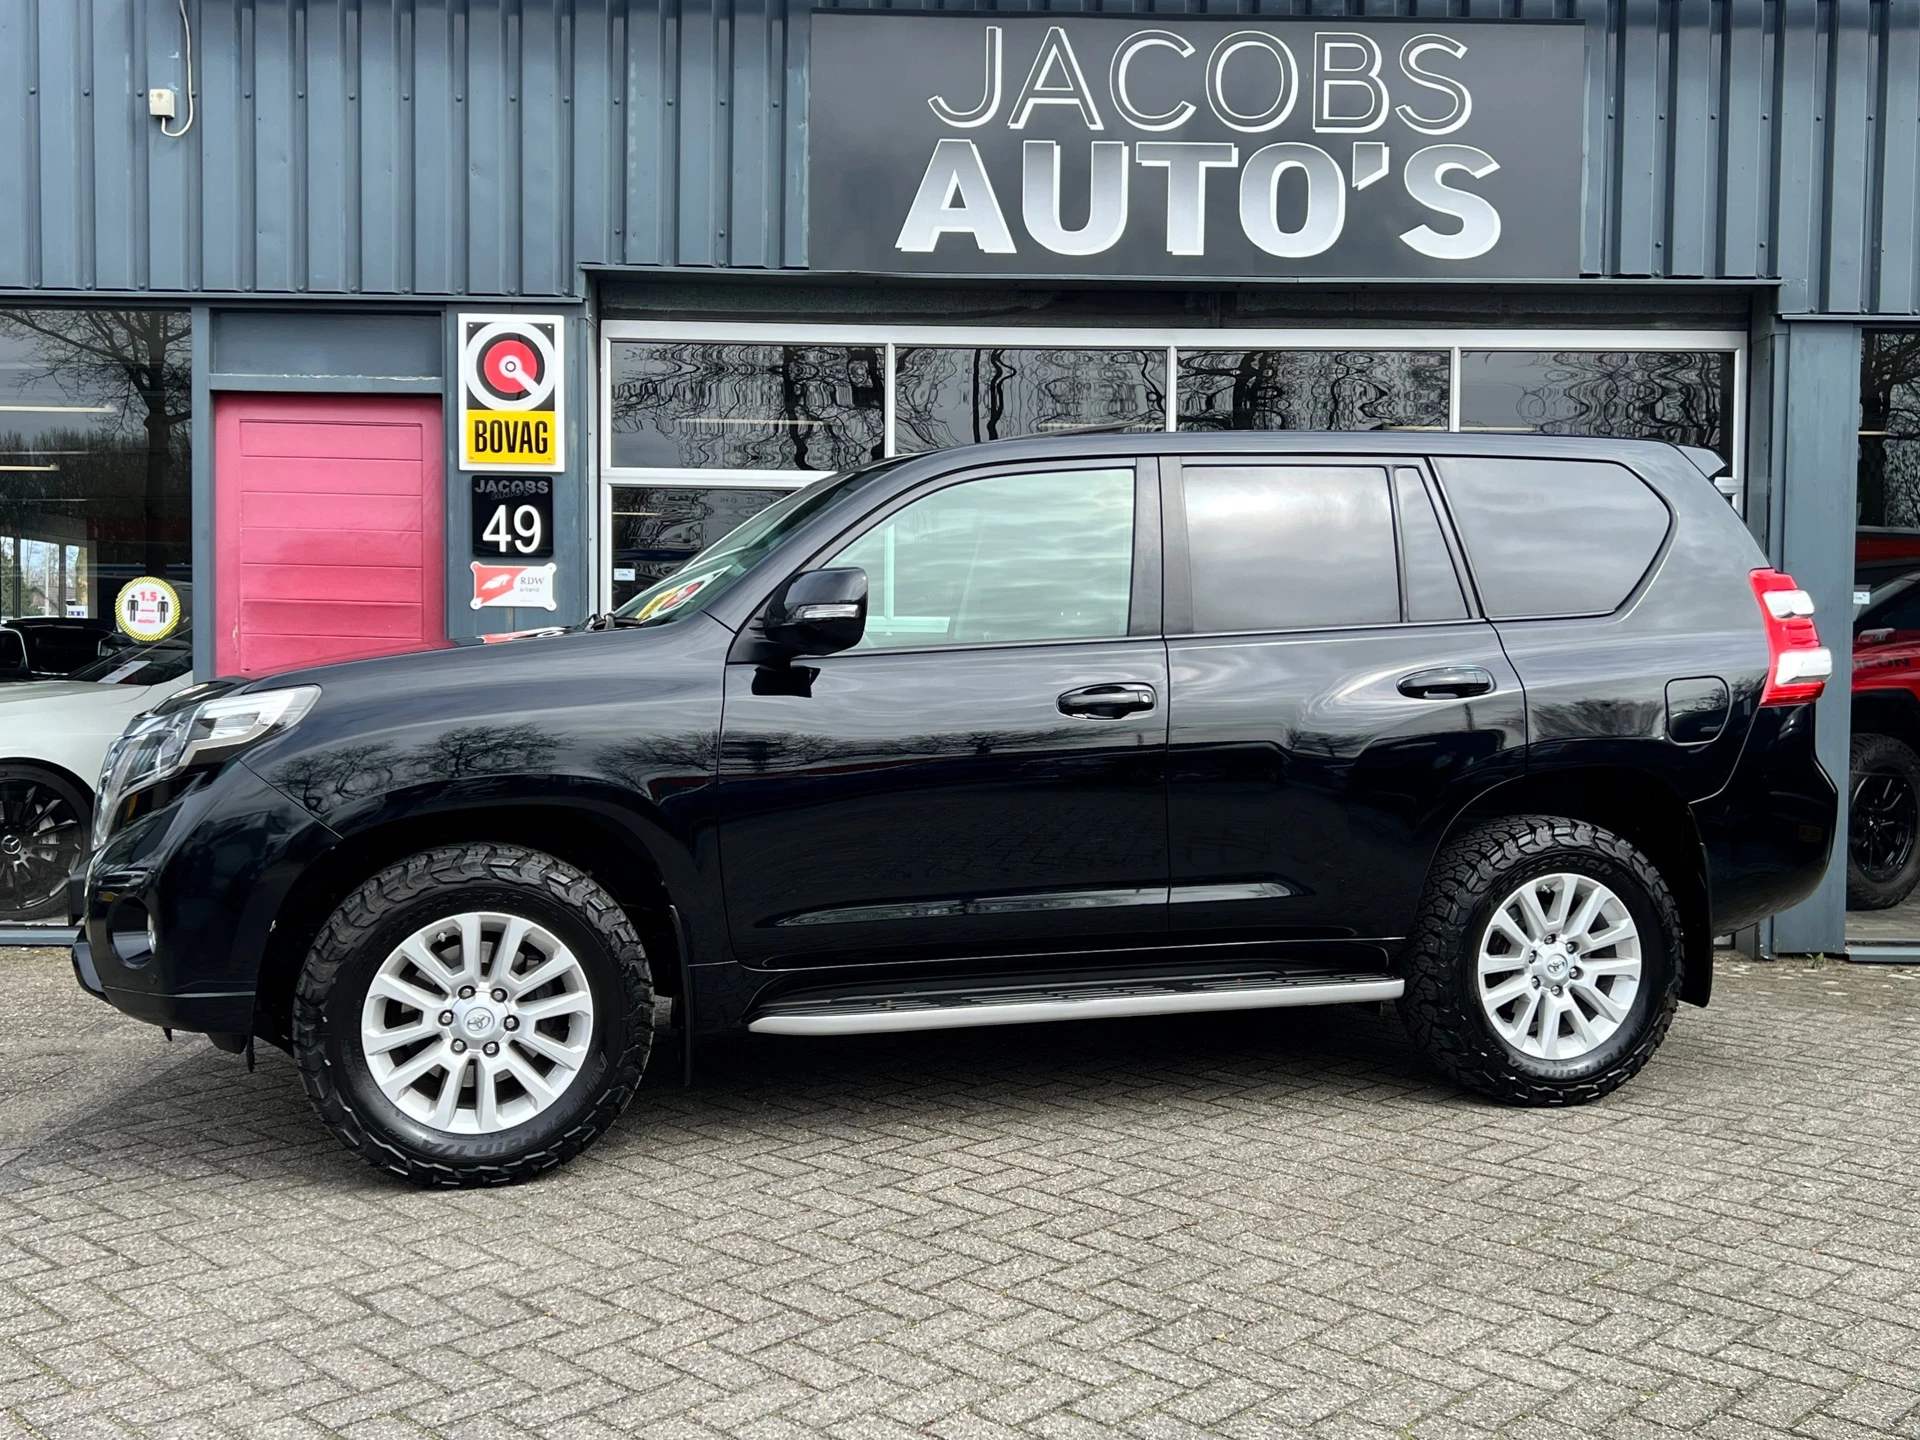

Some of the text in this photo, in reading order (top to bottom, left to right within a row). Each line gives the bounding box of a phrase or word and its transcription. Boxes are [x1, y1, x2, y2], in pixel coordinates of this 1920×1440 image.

[928, 26, 1473, 135] JACOBS
[895, 139, 1501, 260] AUTO'S
[474, 419, 548, 454] BOVAG
[474, 479, 549, 494] JACOBS
[482, 504, 541, 554] 49
[520, 576, 545, 585] RDW
